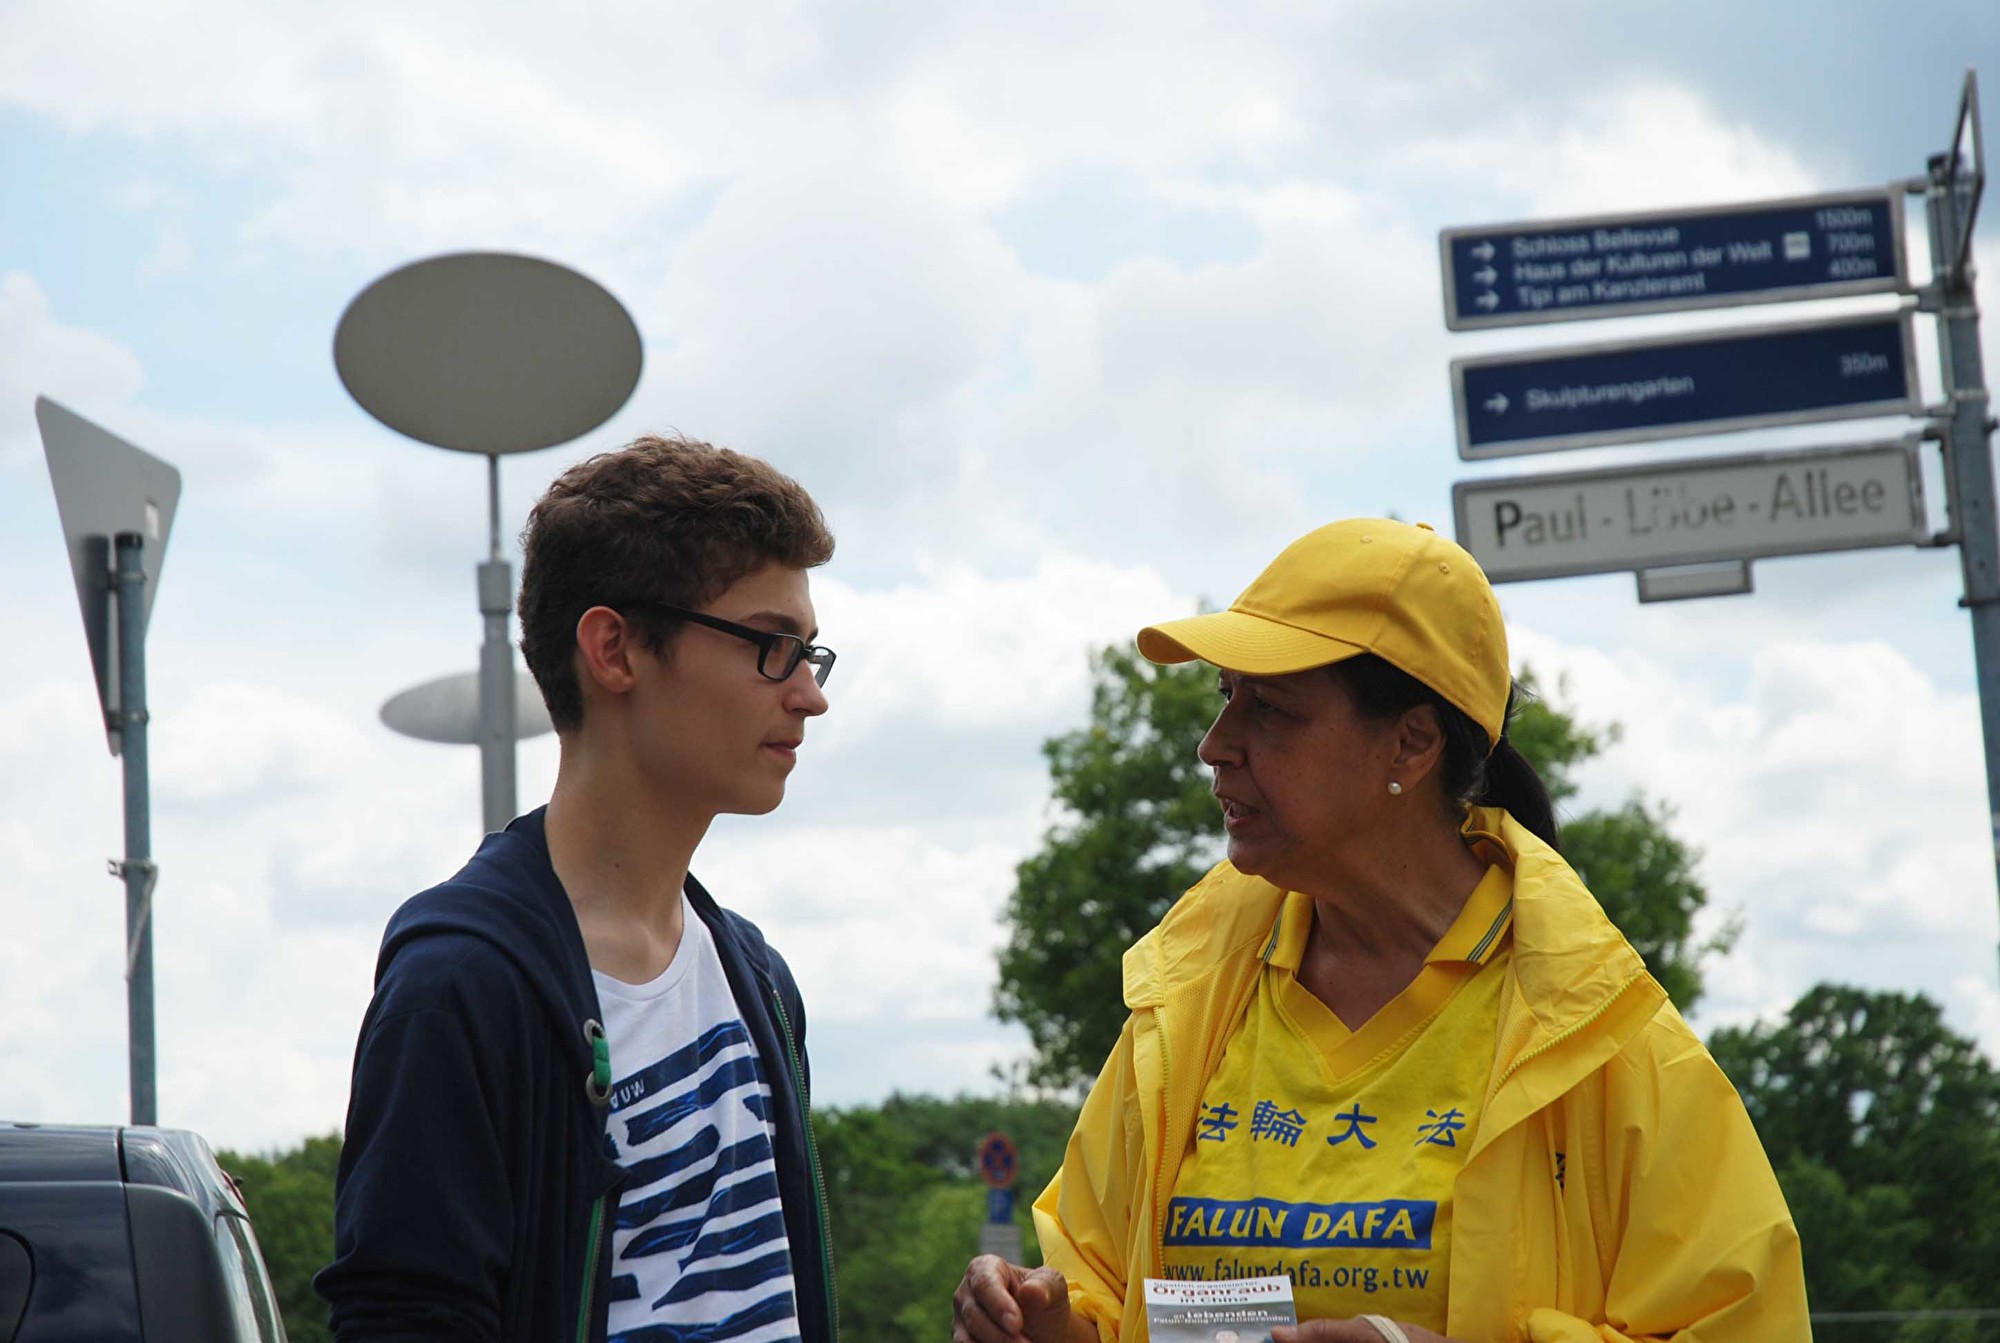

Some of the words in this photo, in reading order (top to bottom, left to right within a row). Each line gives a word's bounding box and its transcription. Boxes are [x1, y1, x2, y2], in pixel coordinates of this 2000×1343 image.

[1511, 236, 1590, 258] Schloss
[1593, 227, 1680, 251] Bellevue
[1514, 262, 1566, 282] Haus
[1570, 258, 1600, 278] der
[1606, 251, 1687, 274] Kulturen
[1692, 246, 1722, 267] der
[1727, 240, 1772, 264] Welt
[1555, 285, 1590, 302] am
[1593, 273, 1706, 299] Kanzleramt
[1526, 374, 1695, 412] Skulpturengarten
[1494, 493, 1588, 548] Paul
[1769, 470, 1886, 523] Allee
[1170, 1205, 1290, 1238] FALUN
[1302, 1208, 1417, 1241] DAFA
[1153, 1284, 1281, 1297] Organraub
[1200, 1296, 1249, 1304] China
